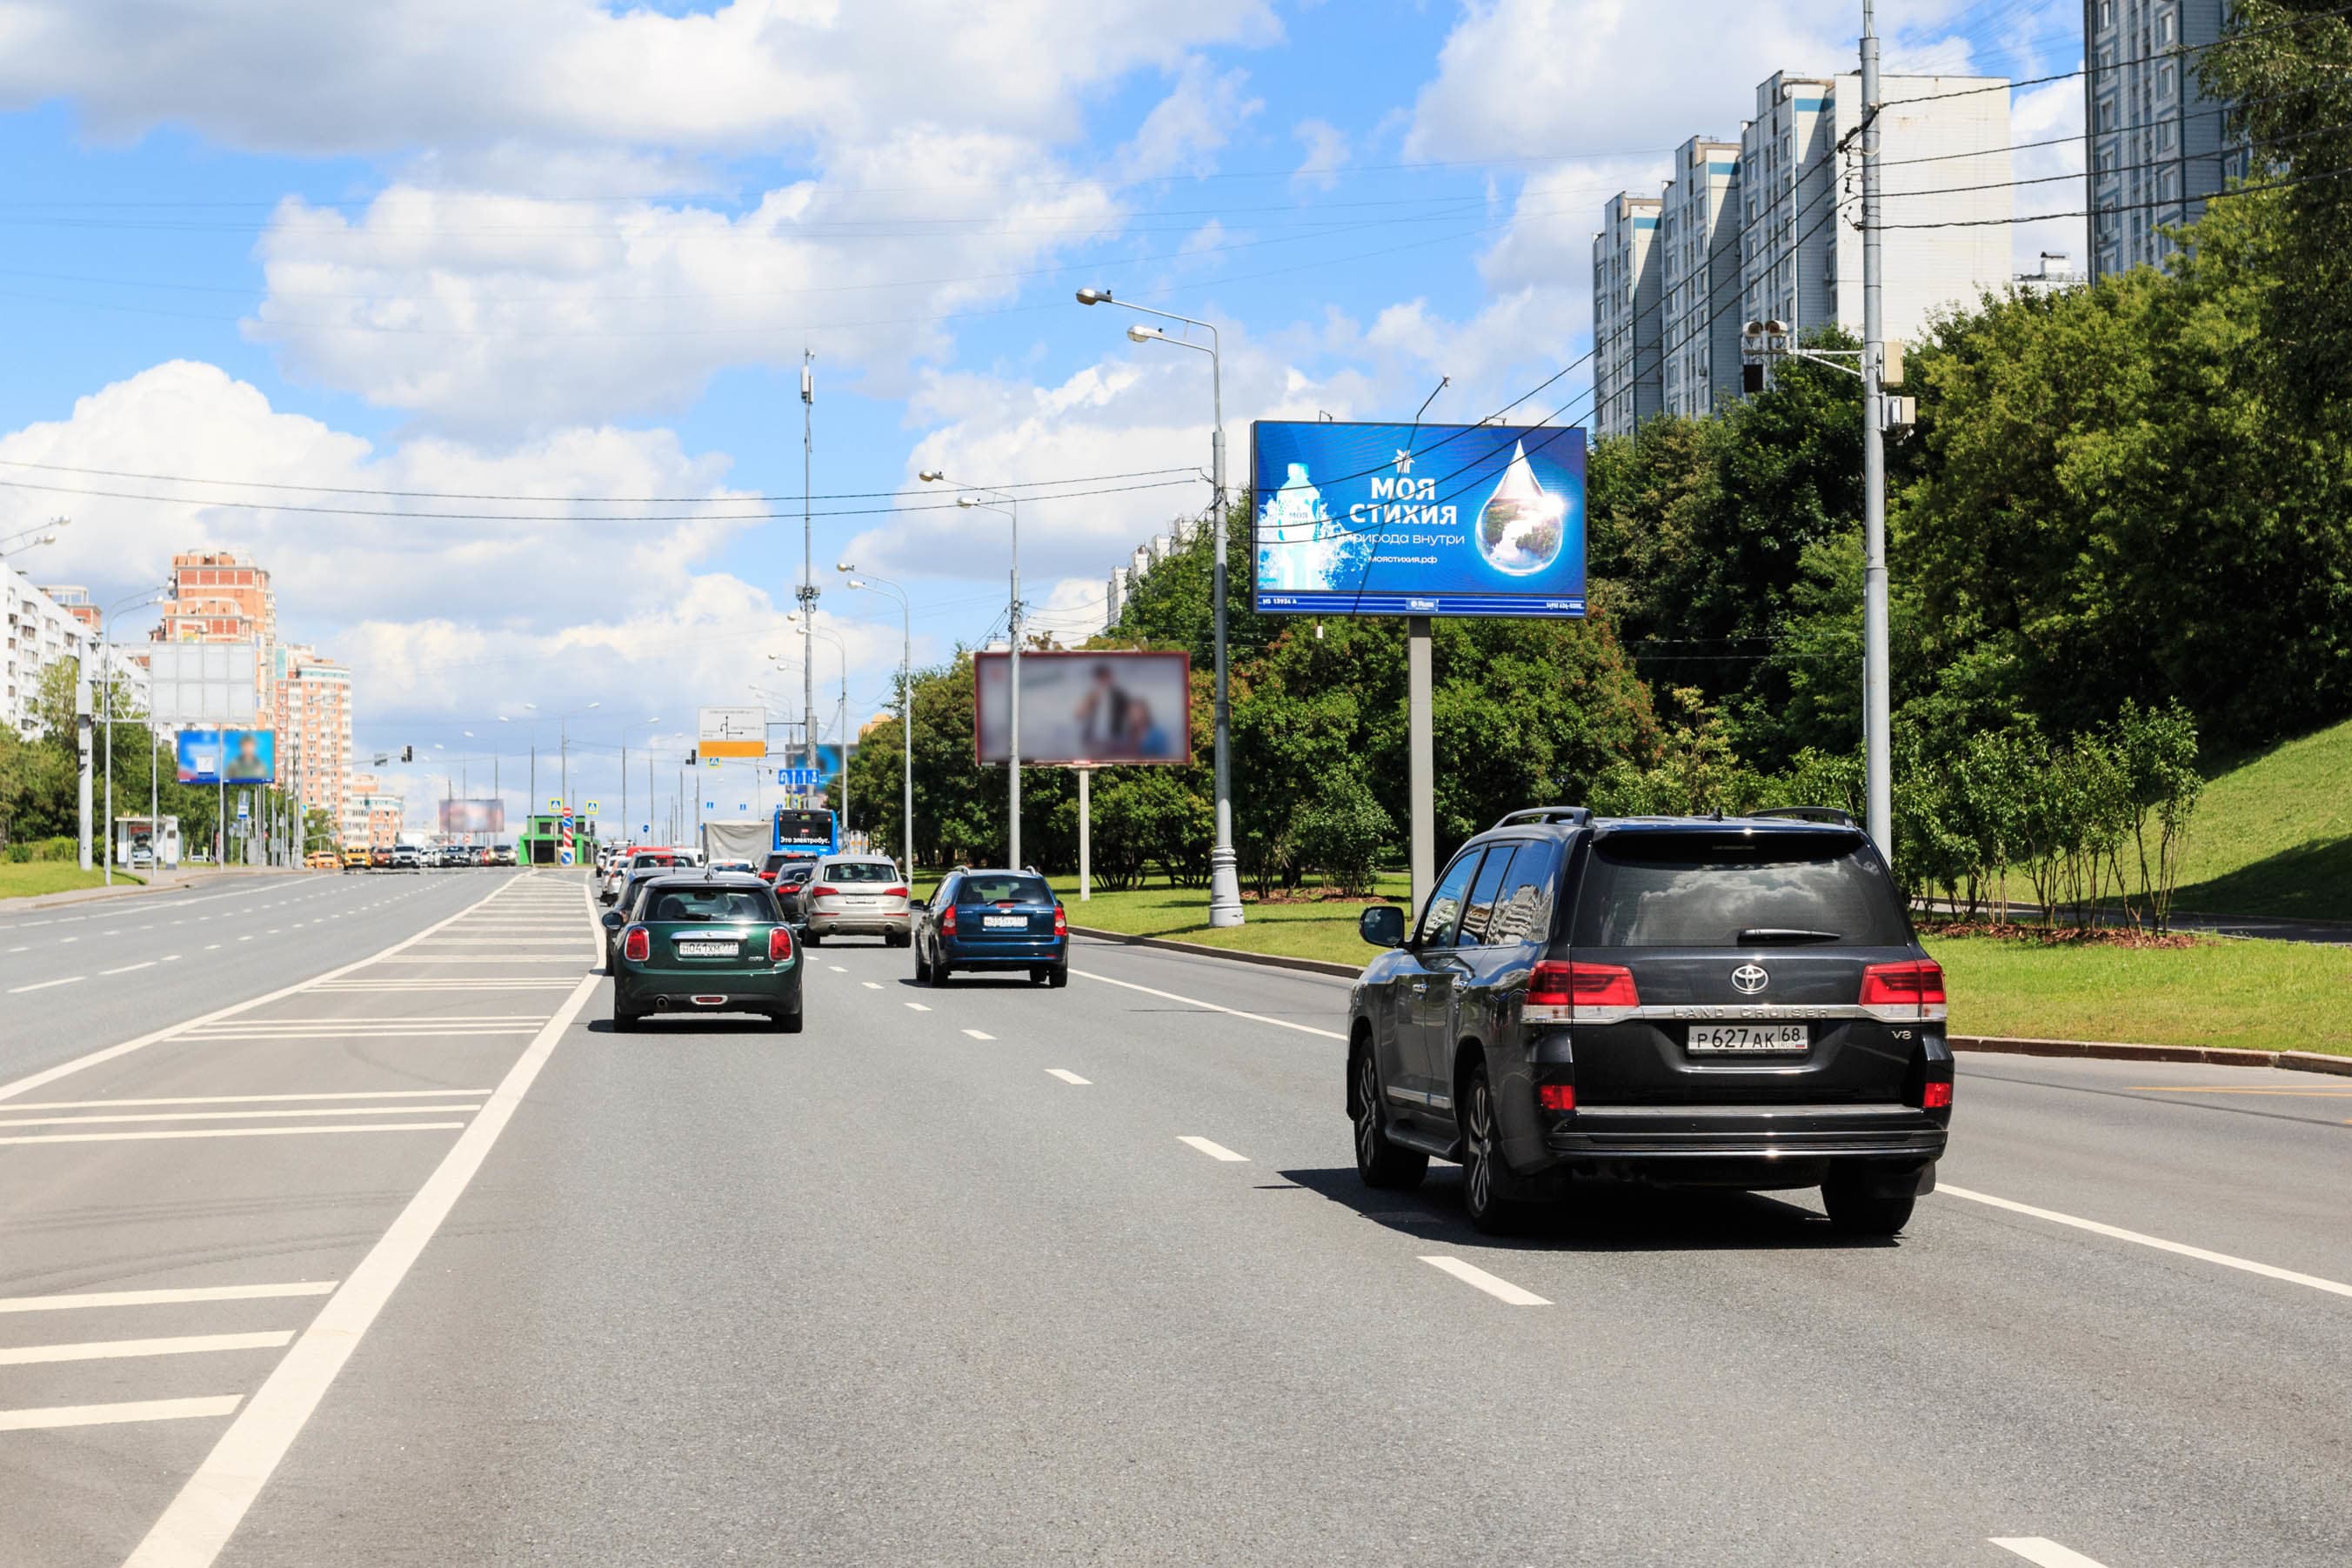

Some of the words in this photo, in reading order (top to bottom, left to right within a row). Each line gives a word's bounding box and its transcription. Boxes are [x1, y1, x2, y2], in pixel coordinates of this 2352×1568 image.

[1371, 477, 1435, 501] МОЯ
[1349, 503, 1458, 525] СТИХИЯ
[1350, 533, 1409, 545] рирода
[1413, 534, 1466, 546] внутри
[1368, 556, 1438, 564] моястихия.рф
[1673, 1007, 1726, 1018] LAND
[1740, 1007, 1829, 1018] CRUISER
[1781, 1027, 1801, 1043] 68
[1891, 1030, 1913, 1040] V8
